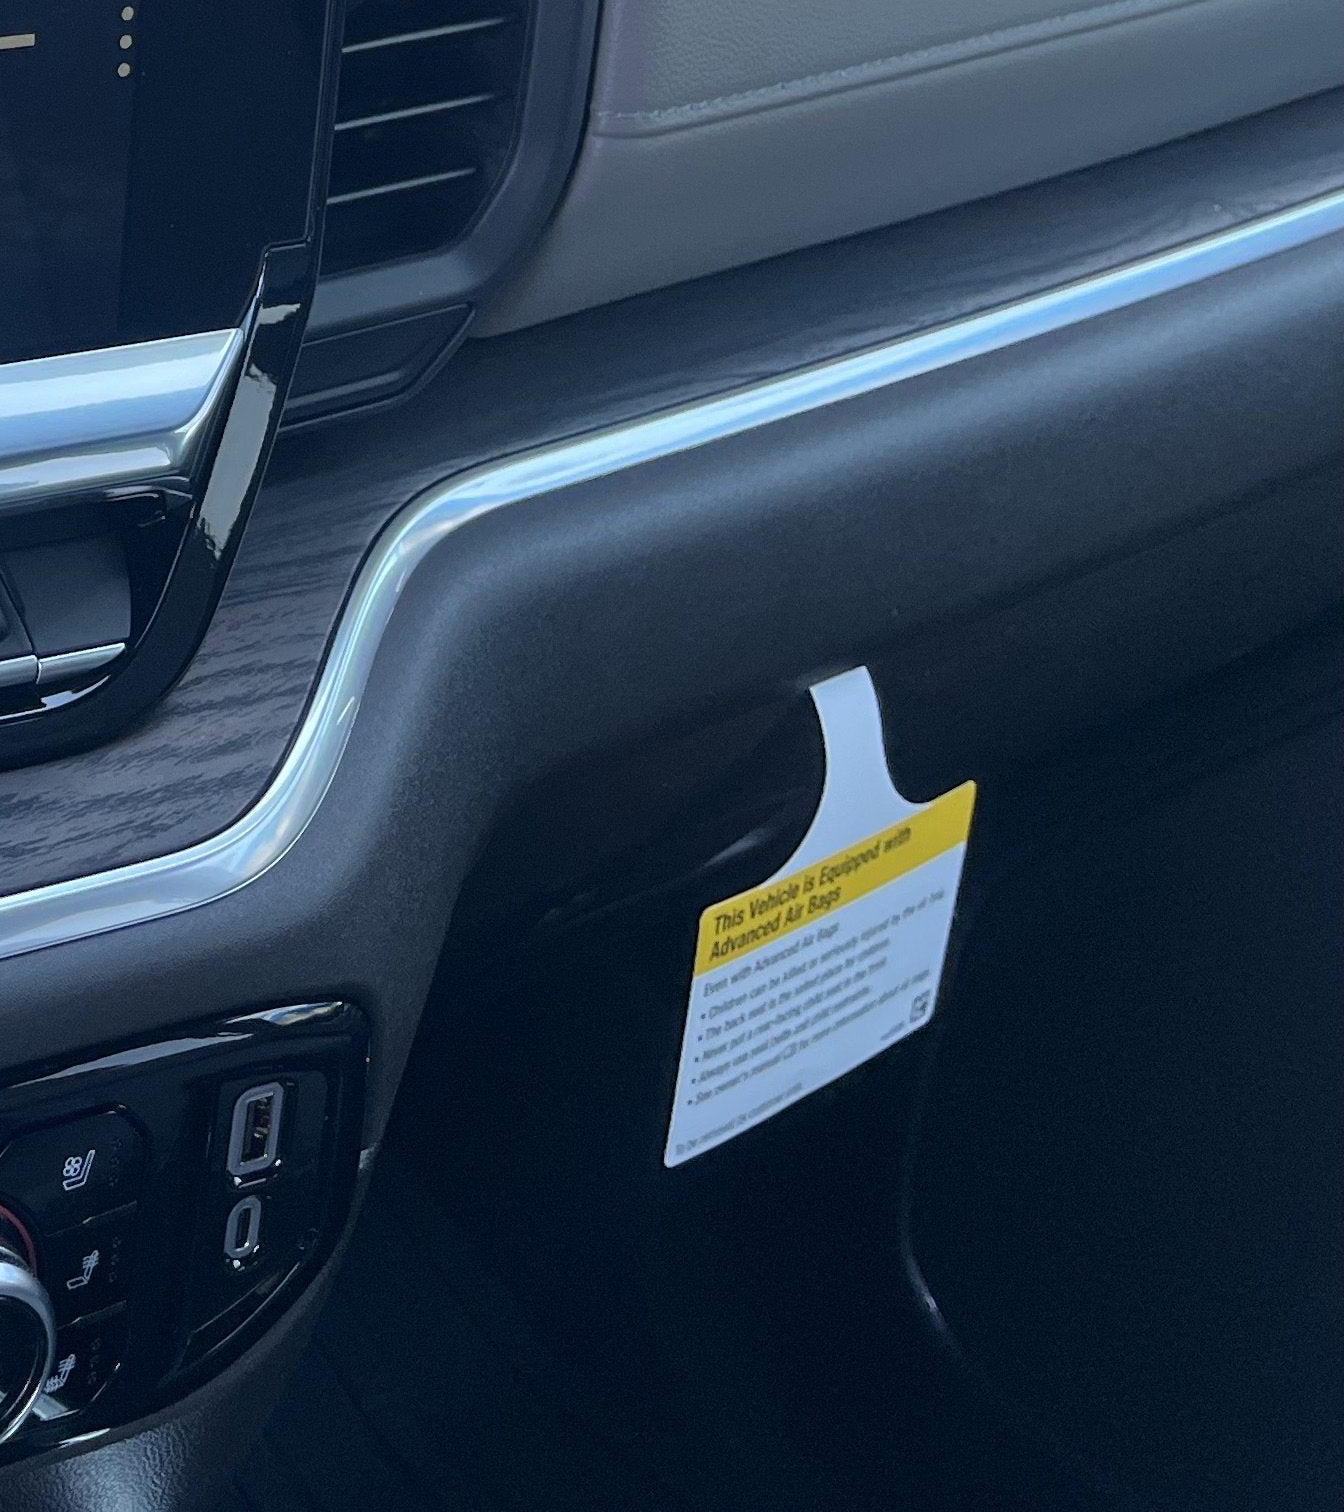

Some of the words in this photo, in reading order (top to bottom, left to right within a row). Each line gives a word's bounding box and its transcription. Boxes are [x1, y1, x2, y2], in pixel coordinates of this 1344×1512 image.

[710, 912, 782, 961] Advanced
[783, 902, 804, 927] Air
[808, 886, 842, 915] Bags
[714, 910, 745, 935] This
[749, 883, 800, 919] Vehicle
[803, 875, 815, 892] is
[819, 840, 882, 888] Equipped
[883, 826, 912, 853] with
